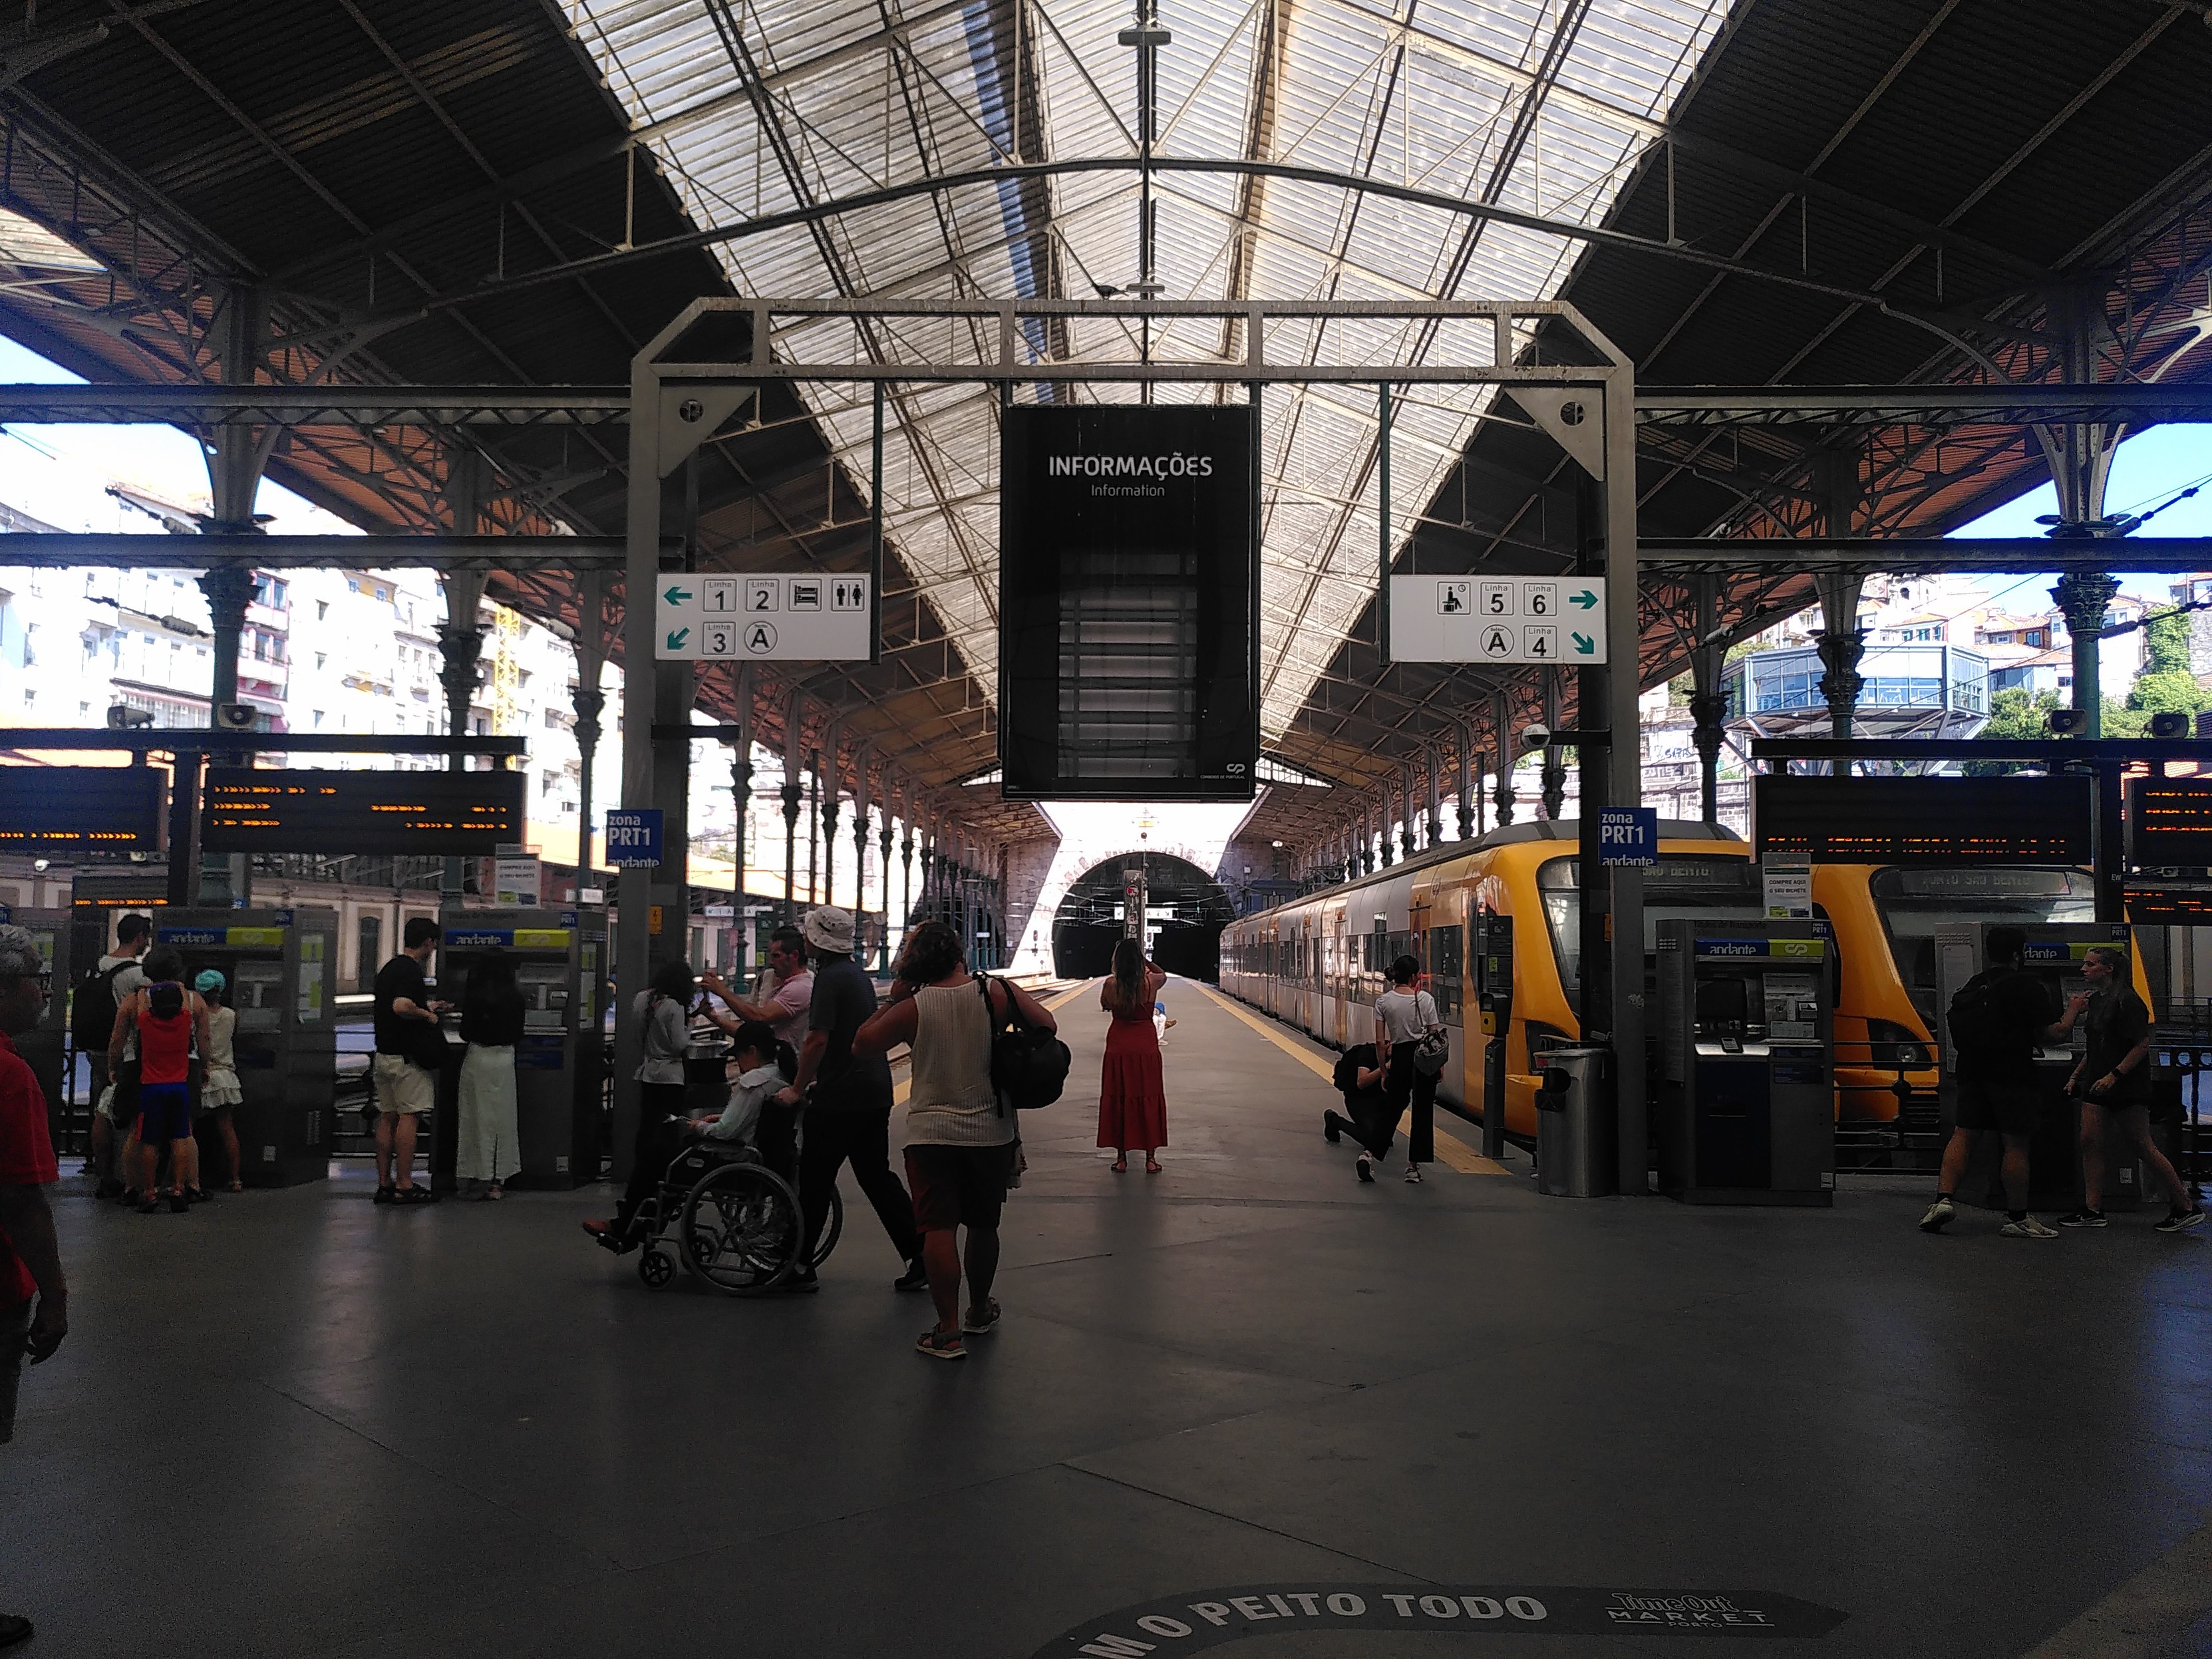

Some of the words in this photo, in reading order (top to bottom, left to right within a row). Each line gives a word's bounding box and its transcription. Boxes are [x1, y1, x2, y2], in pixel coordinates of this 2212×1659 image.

[1048, 452, 1213, 481] INFORMAÇÕES
[1091, 484, 1165, 496] Information
[715, 591, 724, 611] 1
[756, 591, 770, 610] 2
[1490, 593, 1504, 613] 5
[1533, 595, 1546, 614] 6
[713, 633, 726, 653] 3
[751, 628, 770, 648] A
[1488, 632, 1506, 652] A
[1532, 637, 1547, 657] 4
[609, 816, 641, 826] zona
[1601, 814, 1633, 824] zona
[609, 827, 651, 846] PRT1
[1601, 826, 1643, 844] PRT1
[608, 855, 660, 867] andante
[1602, 854, 1654, 866] andante
[456, 933, 501, 945] andante
[1709, 943, 1756, 955] andante
[2024, 947, 2058, 959] dante
[1607, 1610, 1766, 1622] MARKET
[1070, 1633, 1158, 1659] M
[1136, 1614, 1193, 1638] O
[1186, 1592, 1367, 1627] PEITO
[1382, 1593, 1548, 1621] TODO
